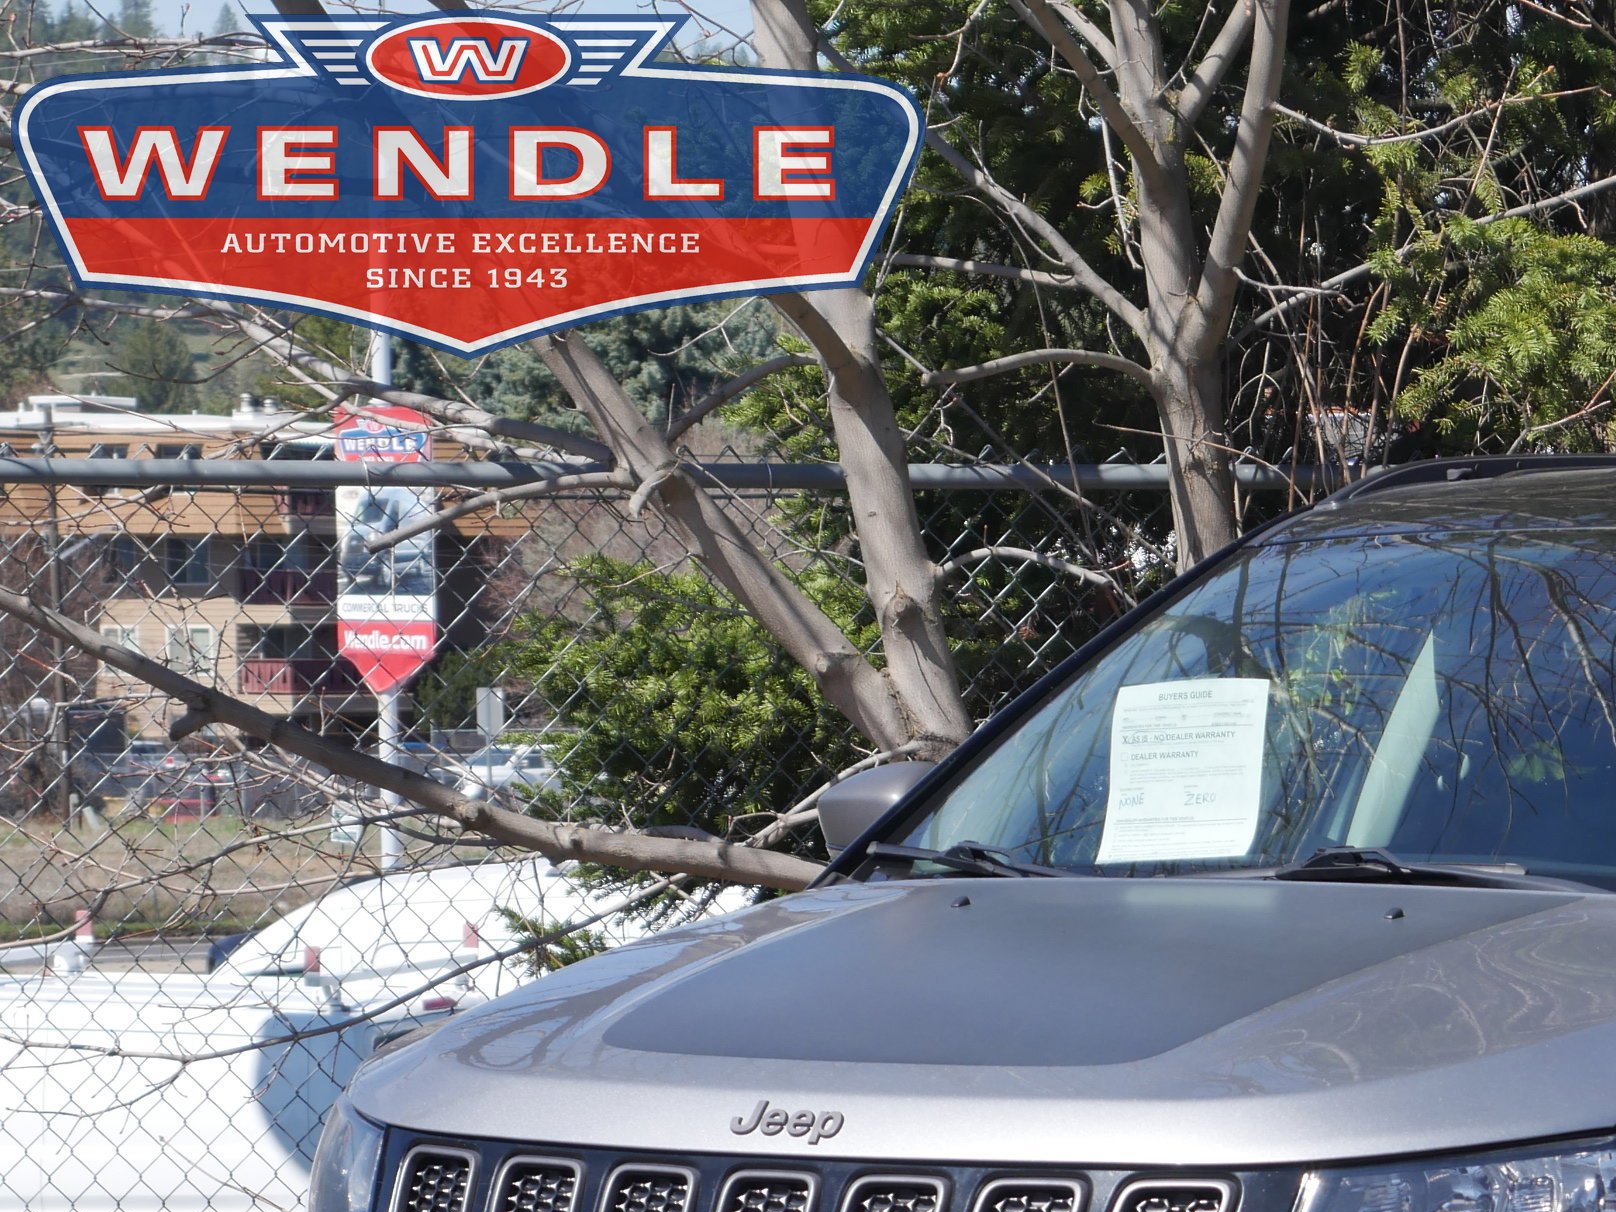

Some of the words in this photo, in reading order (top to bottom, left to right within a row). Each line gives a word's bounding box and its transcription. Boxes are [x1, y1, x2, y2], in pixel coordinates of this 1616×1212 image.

[343, 437, 417, 452] WENDLE
[343, 629, 427, 650] Wendle.com
[1158, 691, 1188, 701] BUYERS
[1190, 690, 1213, 699] GUIDE
[1154, 734, 1165, 742] NO
[1166, 732, 1194, 741] DEALER
[1195, 731, 1236, 740] WARRANTY
[1131, 752, 1158, 761] DEALER
[1159, 751, 1199, 760] WARRANTY
[1118, 793, 1145, 810] NONE
[1184, 792, 1217, 806] ZERO
[729, 1100, 844, 1145] Jeep
